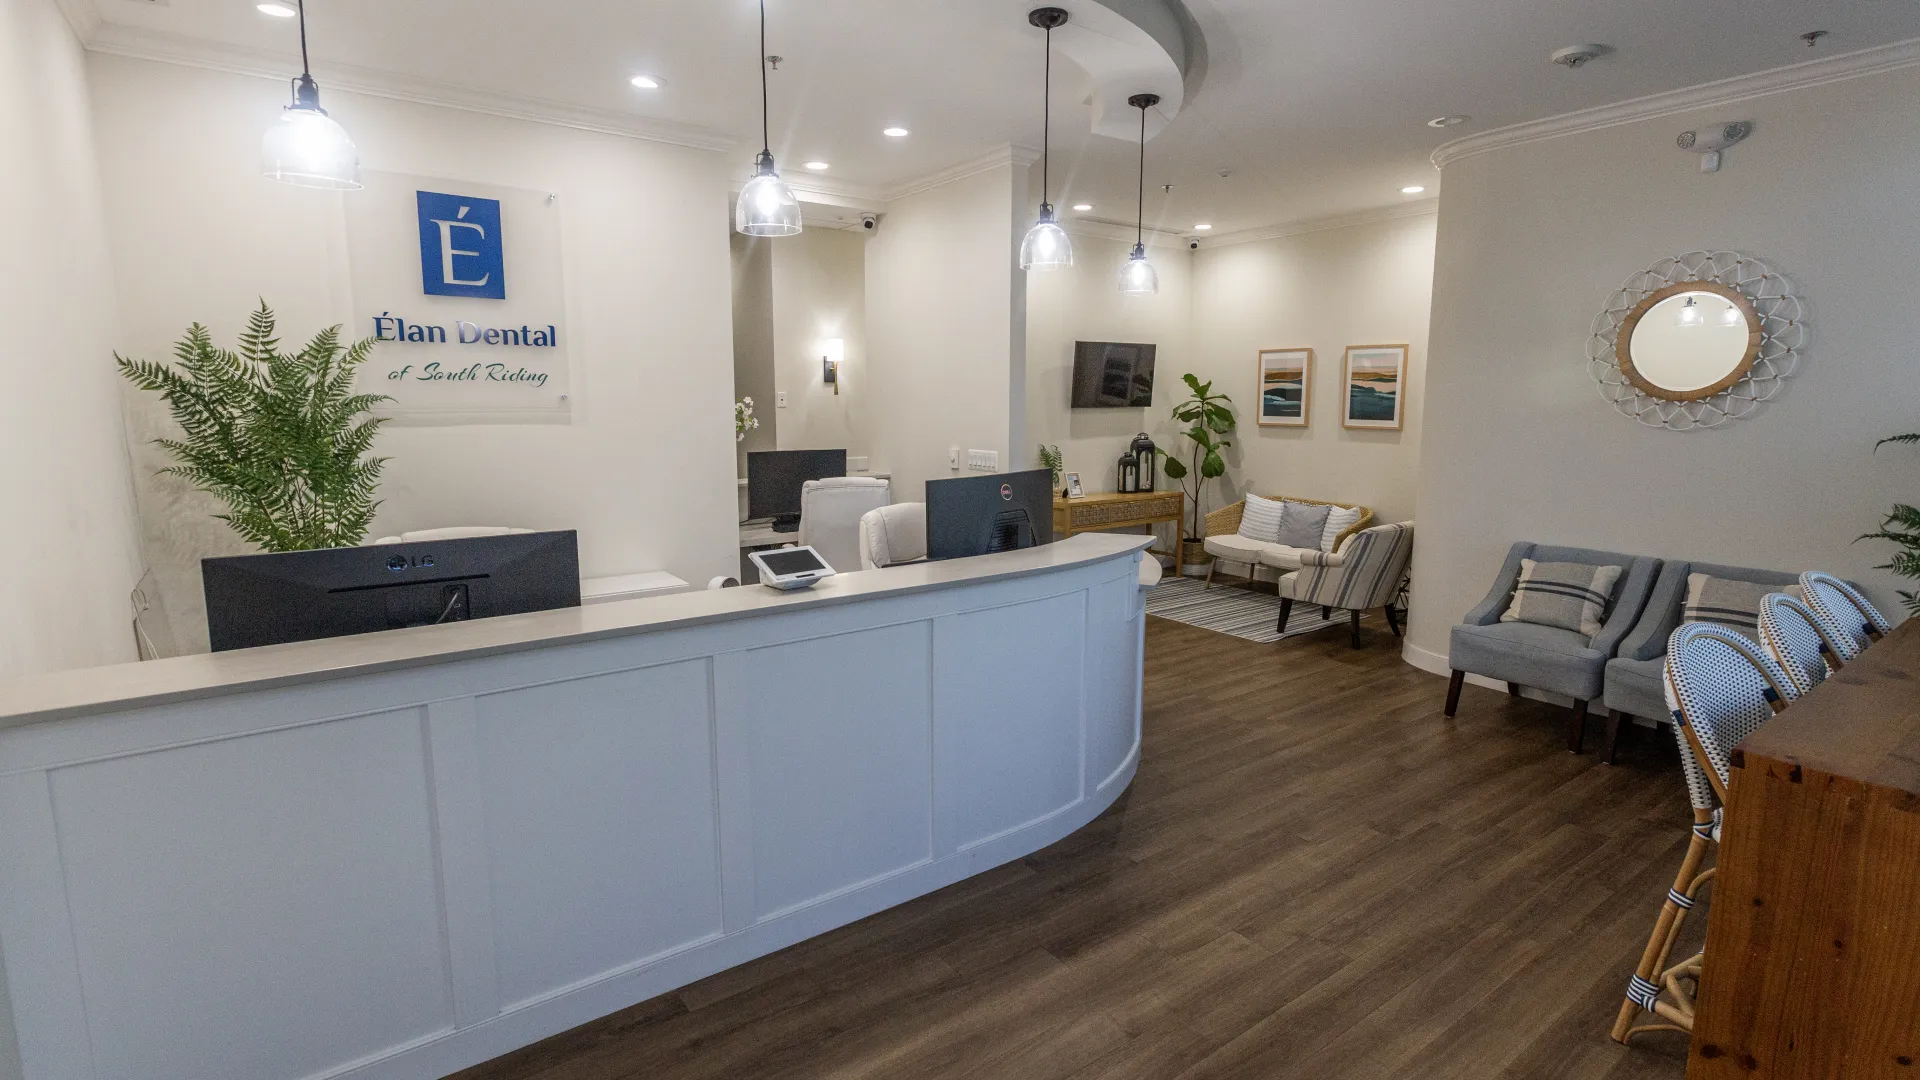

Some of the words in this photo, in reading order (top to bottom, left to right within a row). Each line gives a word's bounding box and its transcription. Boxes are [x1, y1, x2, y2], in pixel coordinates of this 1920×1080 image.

[429, 205, 490, 287] É
[372, 311, 447, 344] Élan
[455, 320, 557, 348] Dental
[387, 364, 415, 382] of
[416, 362, 482, 382] South
[485, 362, 549, 388] Riding
[411, 555, 434, 567] LG
